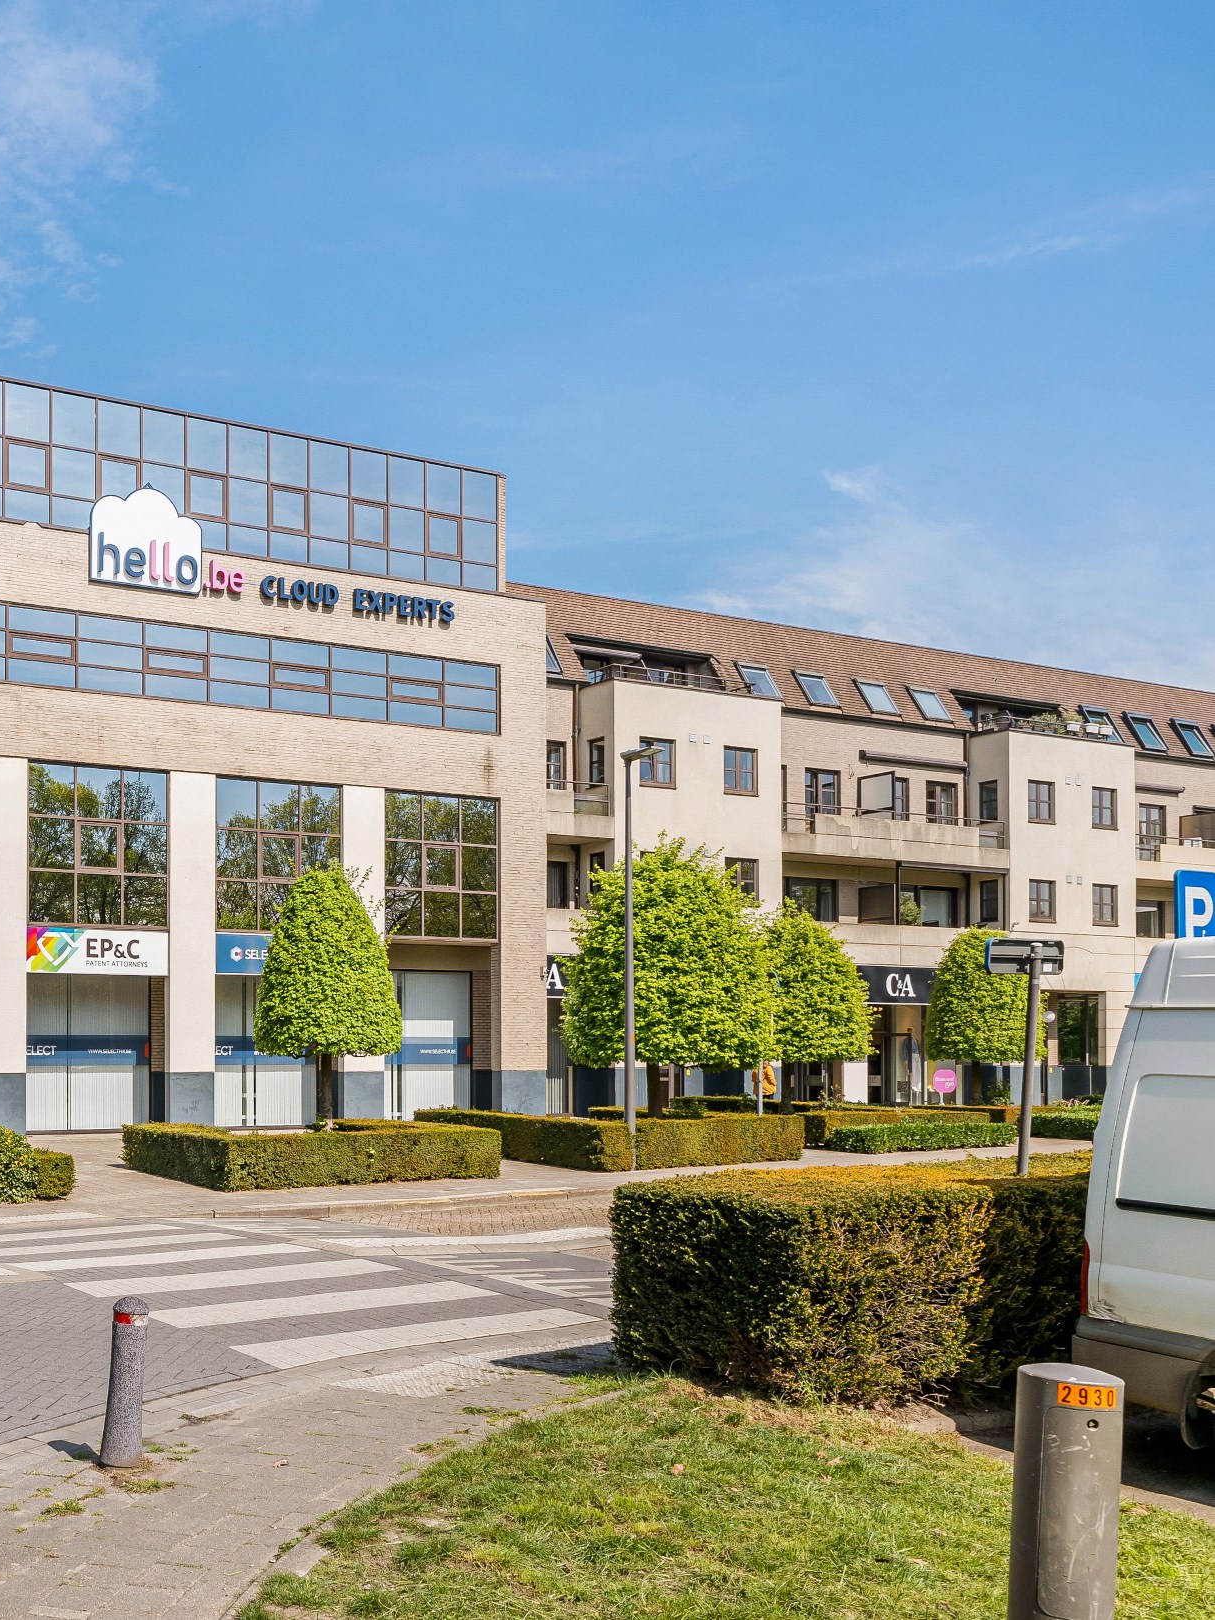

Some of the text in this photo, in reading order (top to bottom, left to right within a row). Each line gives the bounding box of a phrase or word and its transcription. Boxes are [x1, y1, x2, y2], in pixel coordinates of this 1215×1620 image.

[260, 575, 339, 606] CLOUD
[353, 588, 455, 622] EXPERTS
[1185, 885, 1214, 938] P
[86, 938, 140, 960] EP&C
[244, 949, 269, 960] SELE
[111, 960, 148, 968] ATTORNEYS
[546, 963, 564, 990] A
[885, 973, 916, 998] C&A
[26, 1045, 57, 1056] ELECT
[215, 1045, 234, 1056] ECT
[1061, 1385, 1114, 1407] 2930
